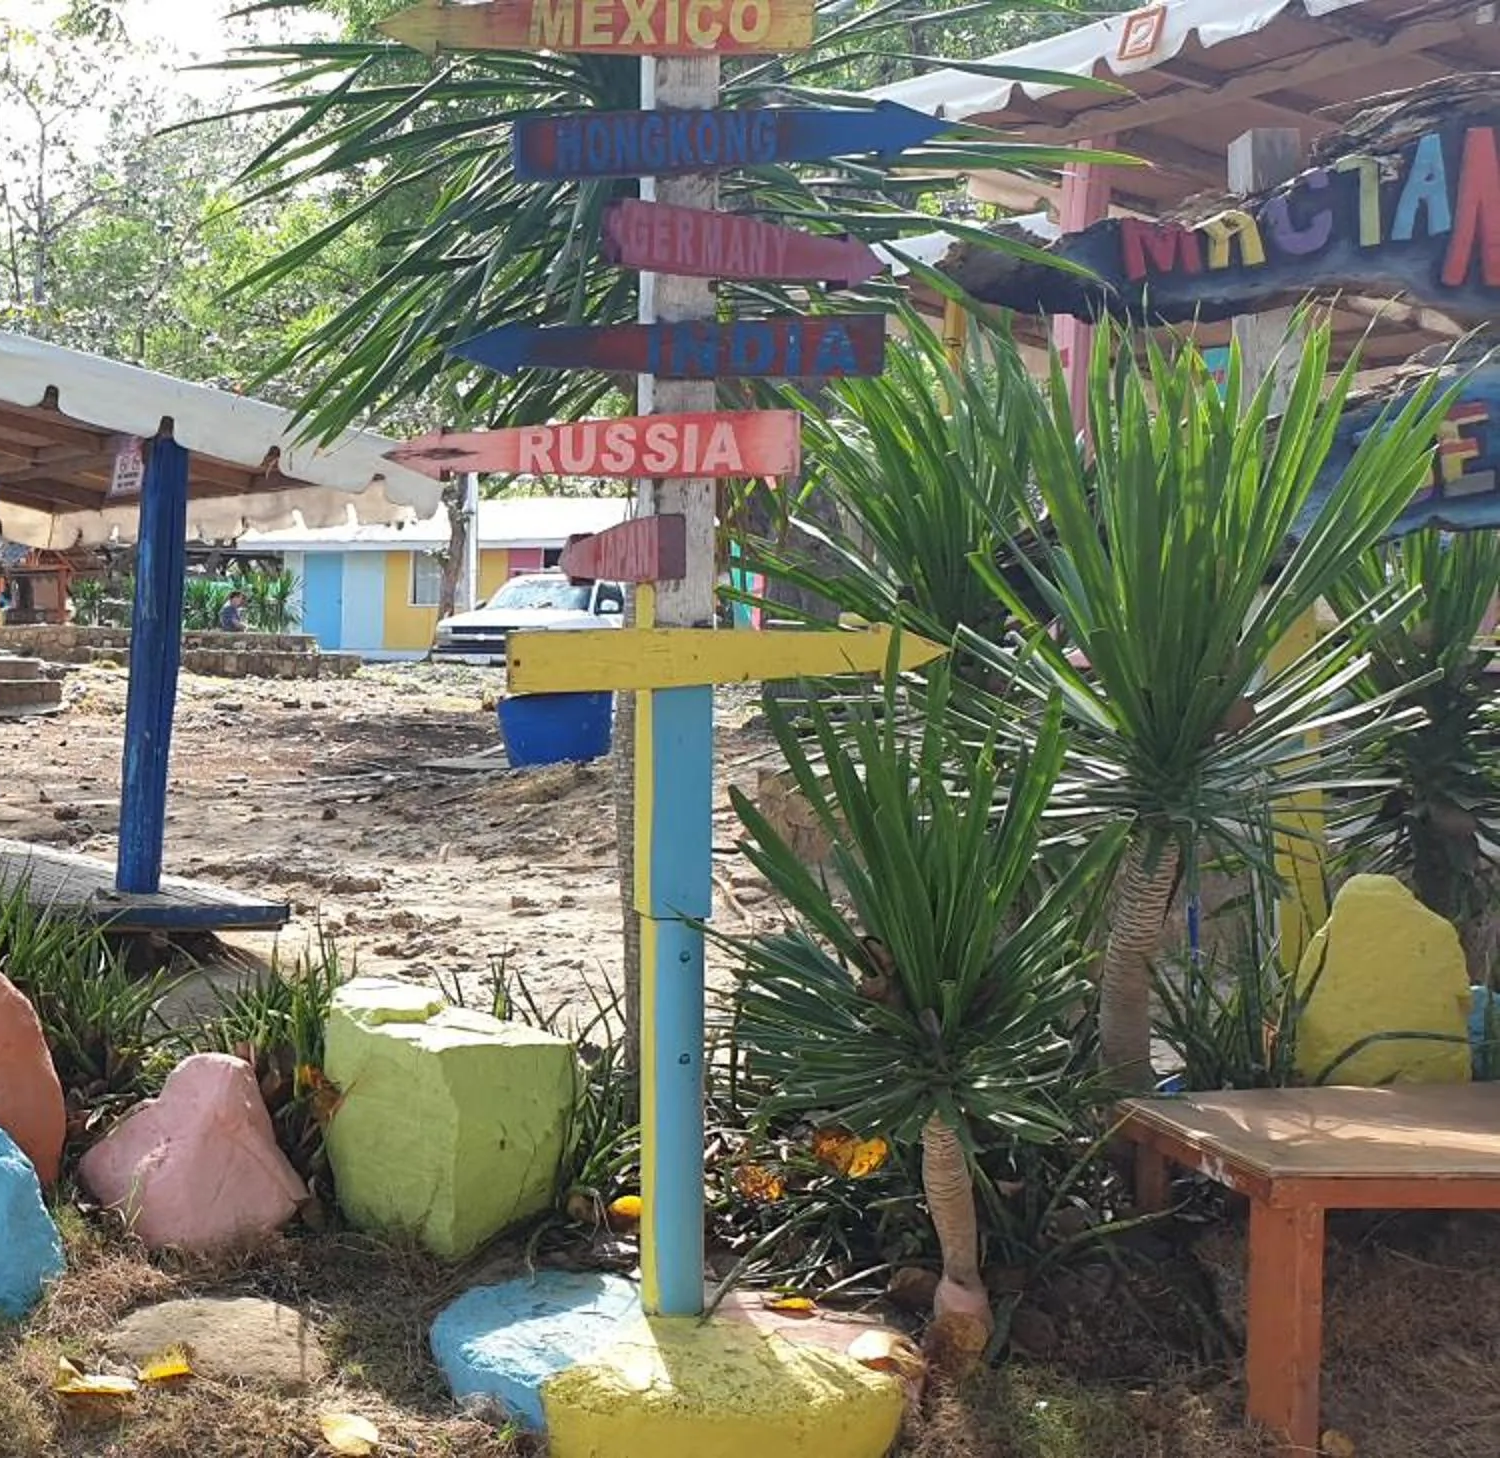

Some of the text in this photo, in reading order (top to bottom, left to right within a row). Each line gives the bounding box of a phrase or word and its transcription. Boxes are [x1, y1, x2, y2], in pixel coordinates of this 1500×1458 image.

[528, 0, 773, 51] MEXICO
[553, 109, 778, 181] HONGKONG
[628, 216, 790, 275] GERMANY
[647, 321, 861, 377] INDIA
[518, 422, 744, 475] RUSSIA
[597, 519, 659, 579] JAPAN
